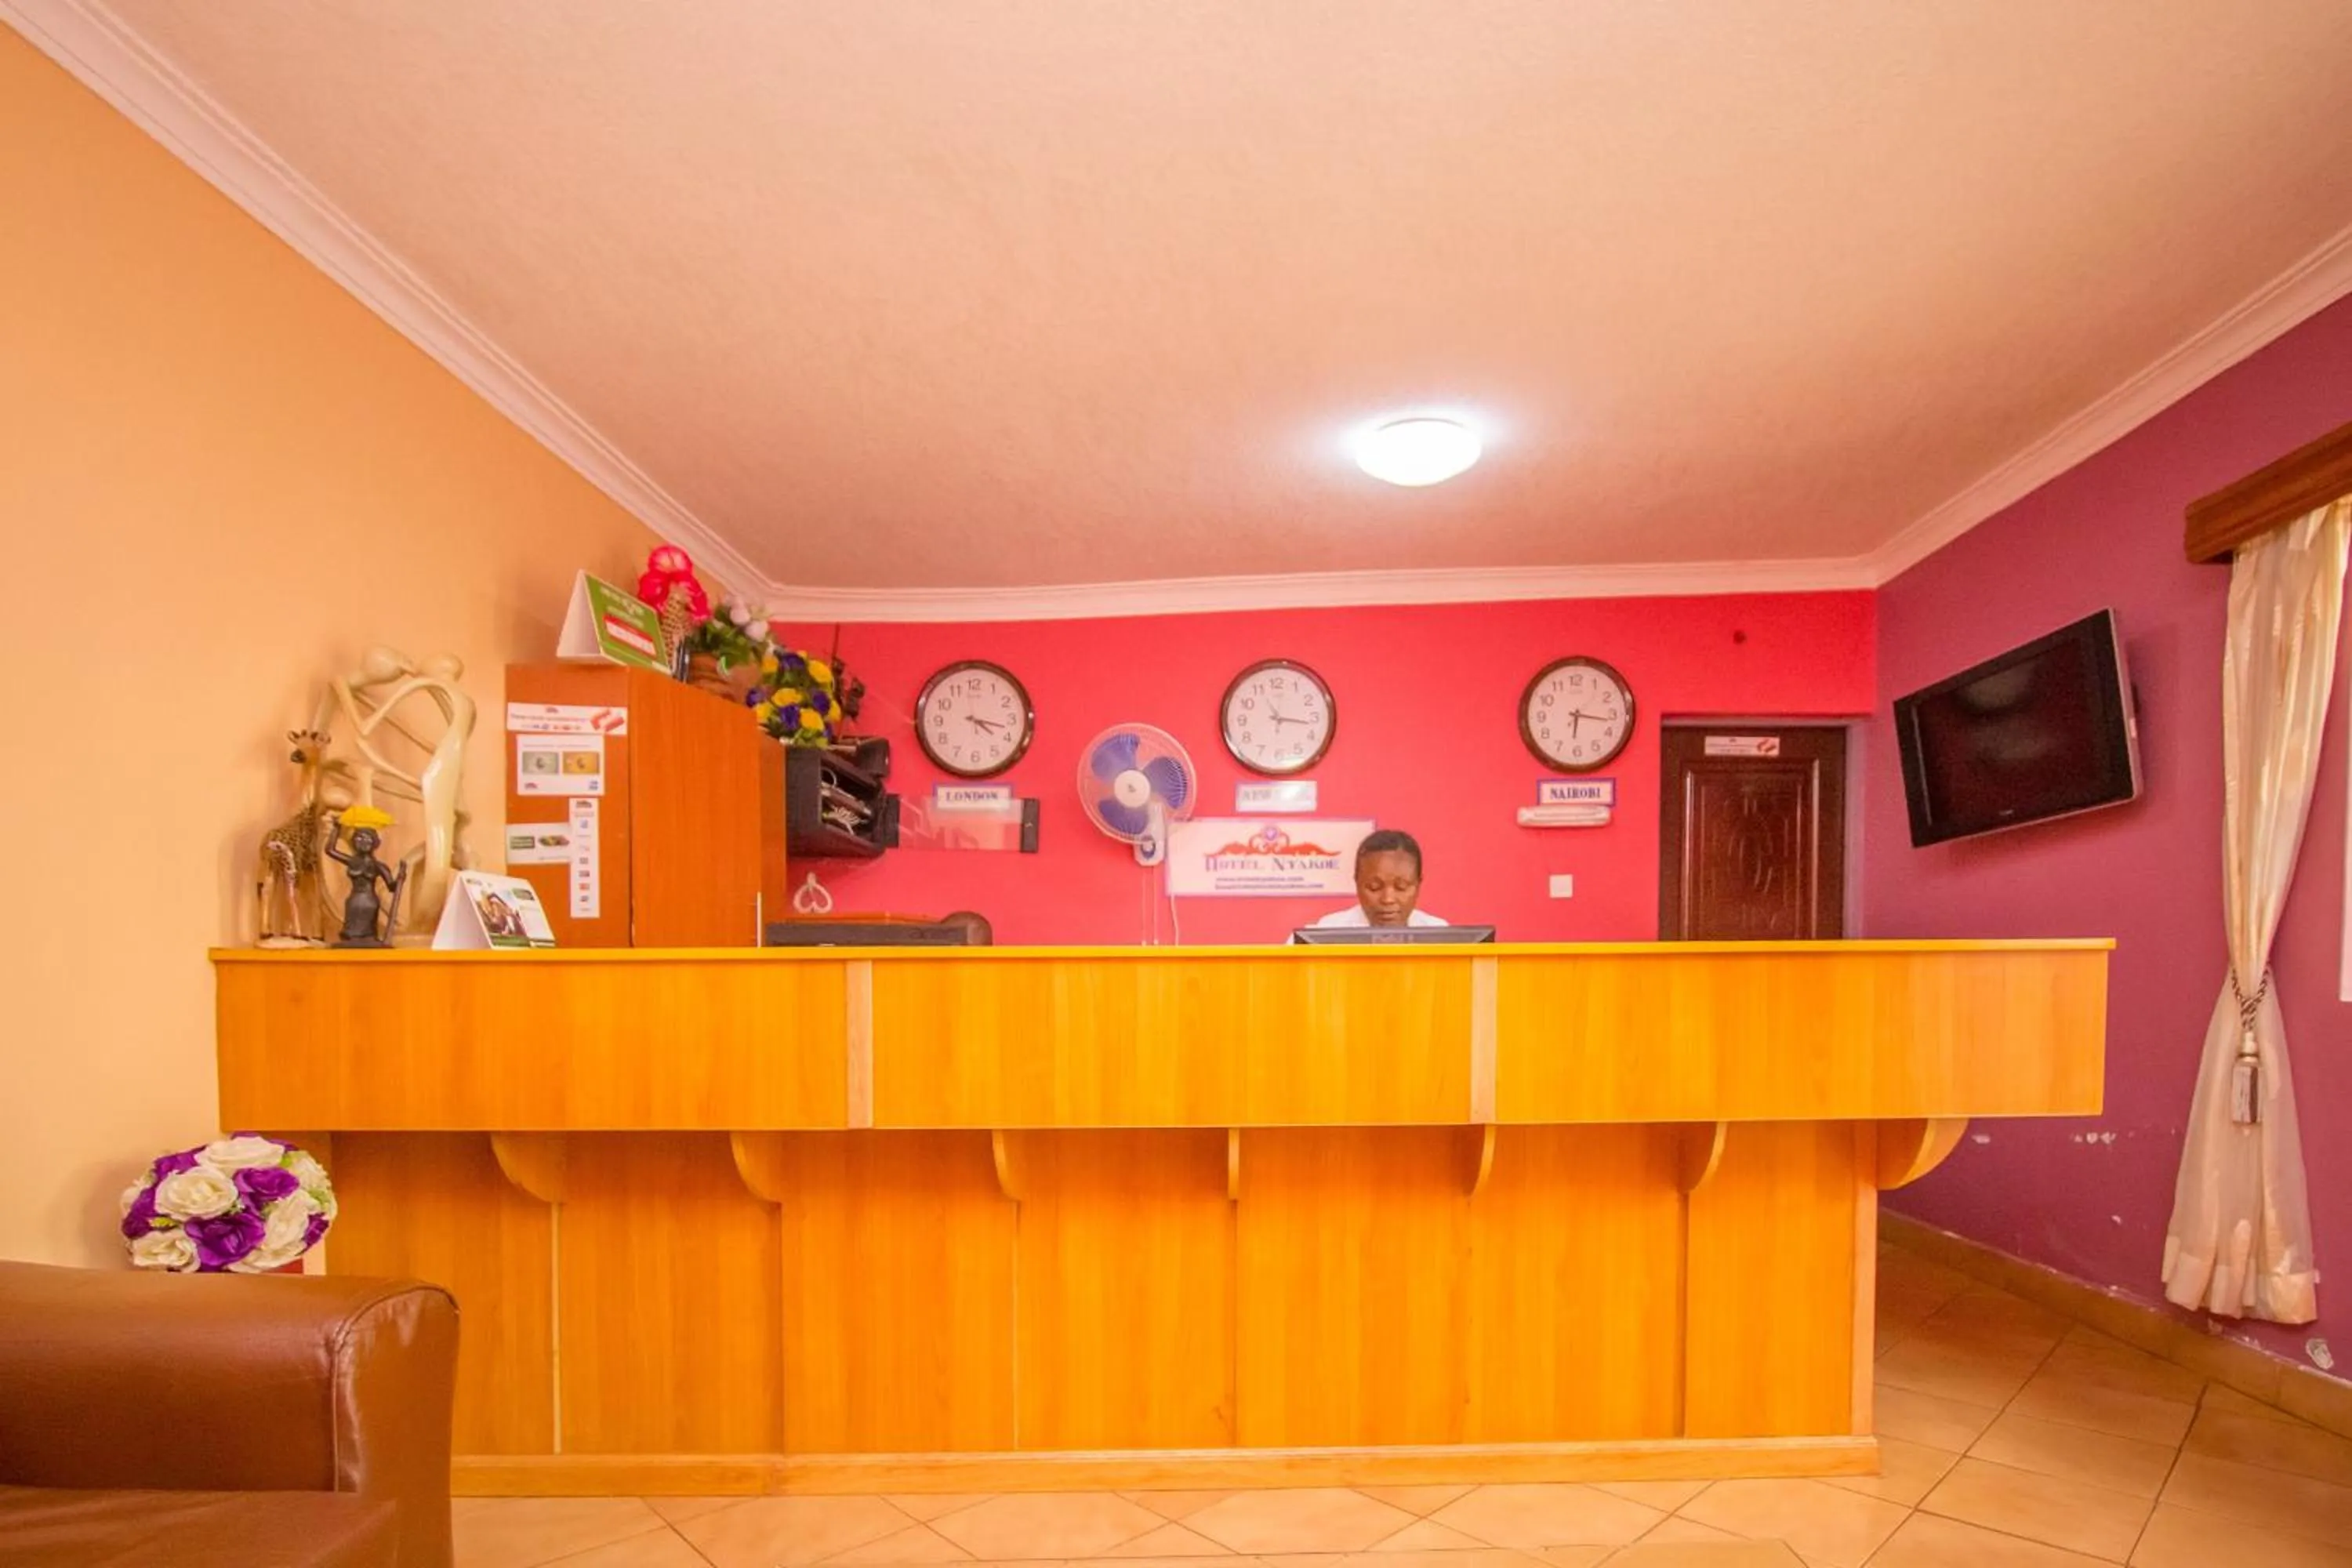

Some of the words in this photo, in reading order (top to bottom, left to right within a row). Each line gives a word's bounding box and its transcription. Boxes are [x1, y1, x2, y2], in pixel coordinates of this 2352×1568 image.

[967, 678, 982, 691] 12
[1269, 677, 1284, 690] 12
[1552, 680, 1564, 692] 11
[1569, 674, 1583, 687] 12
[949, 684, 962, 698] 11
[1251, 684, 1265, 695] 11
[1001, 696, 1011, 708] 2
[1303, 695, 1313, 707] 2
[1540, 693, 1555, 707] 10
[1602, 691, 1612, 703] 2
[938, 698, 952, 711] 10
[1240, 697, 1254, 711] 10
[1007, 713, 1017, 725] 3
[1309, 712, 1319, 724] 3
[1537, 711, 1547, 724] 9
[1608, 708, 1617, 720] 3
[933, 715, 943, 727] 9
[1236, 714, 1247, 727] 9
[1003, 731, 1012, 742] 4
[1241, 731, 1252, 744] 8
[1307, 730, 1316, 742] 4
[1541, 728, 1551, 739] 8
[1604, 726, 1613, 738] 4
[938, 732, 948, 745] 8
[953, 746, 961, 758] 7
[990, 745, 1000, 757] 5
[1256, 745, 1266, 757] 7
[1294, 742, 1304, 755] 5
[1555, 740, 1564, 753] 7
[1572, 746, 1582, 758] 6
[1591, 739, 1601, 753] 5
[970, 750, 980, 763] 6
[946, 790, 999, 802] LONDON
[1549, 787, 1601, 800] NAIROBI
